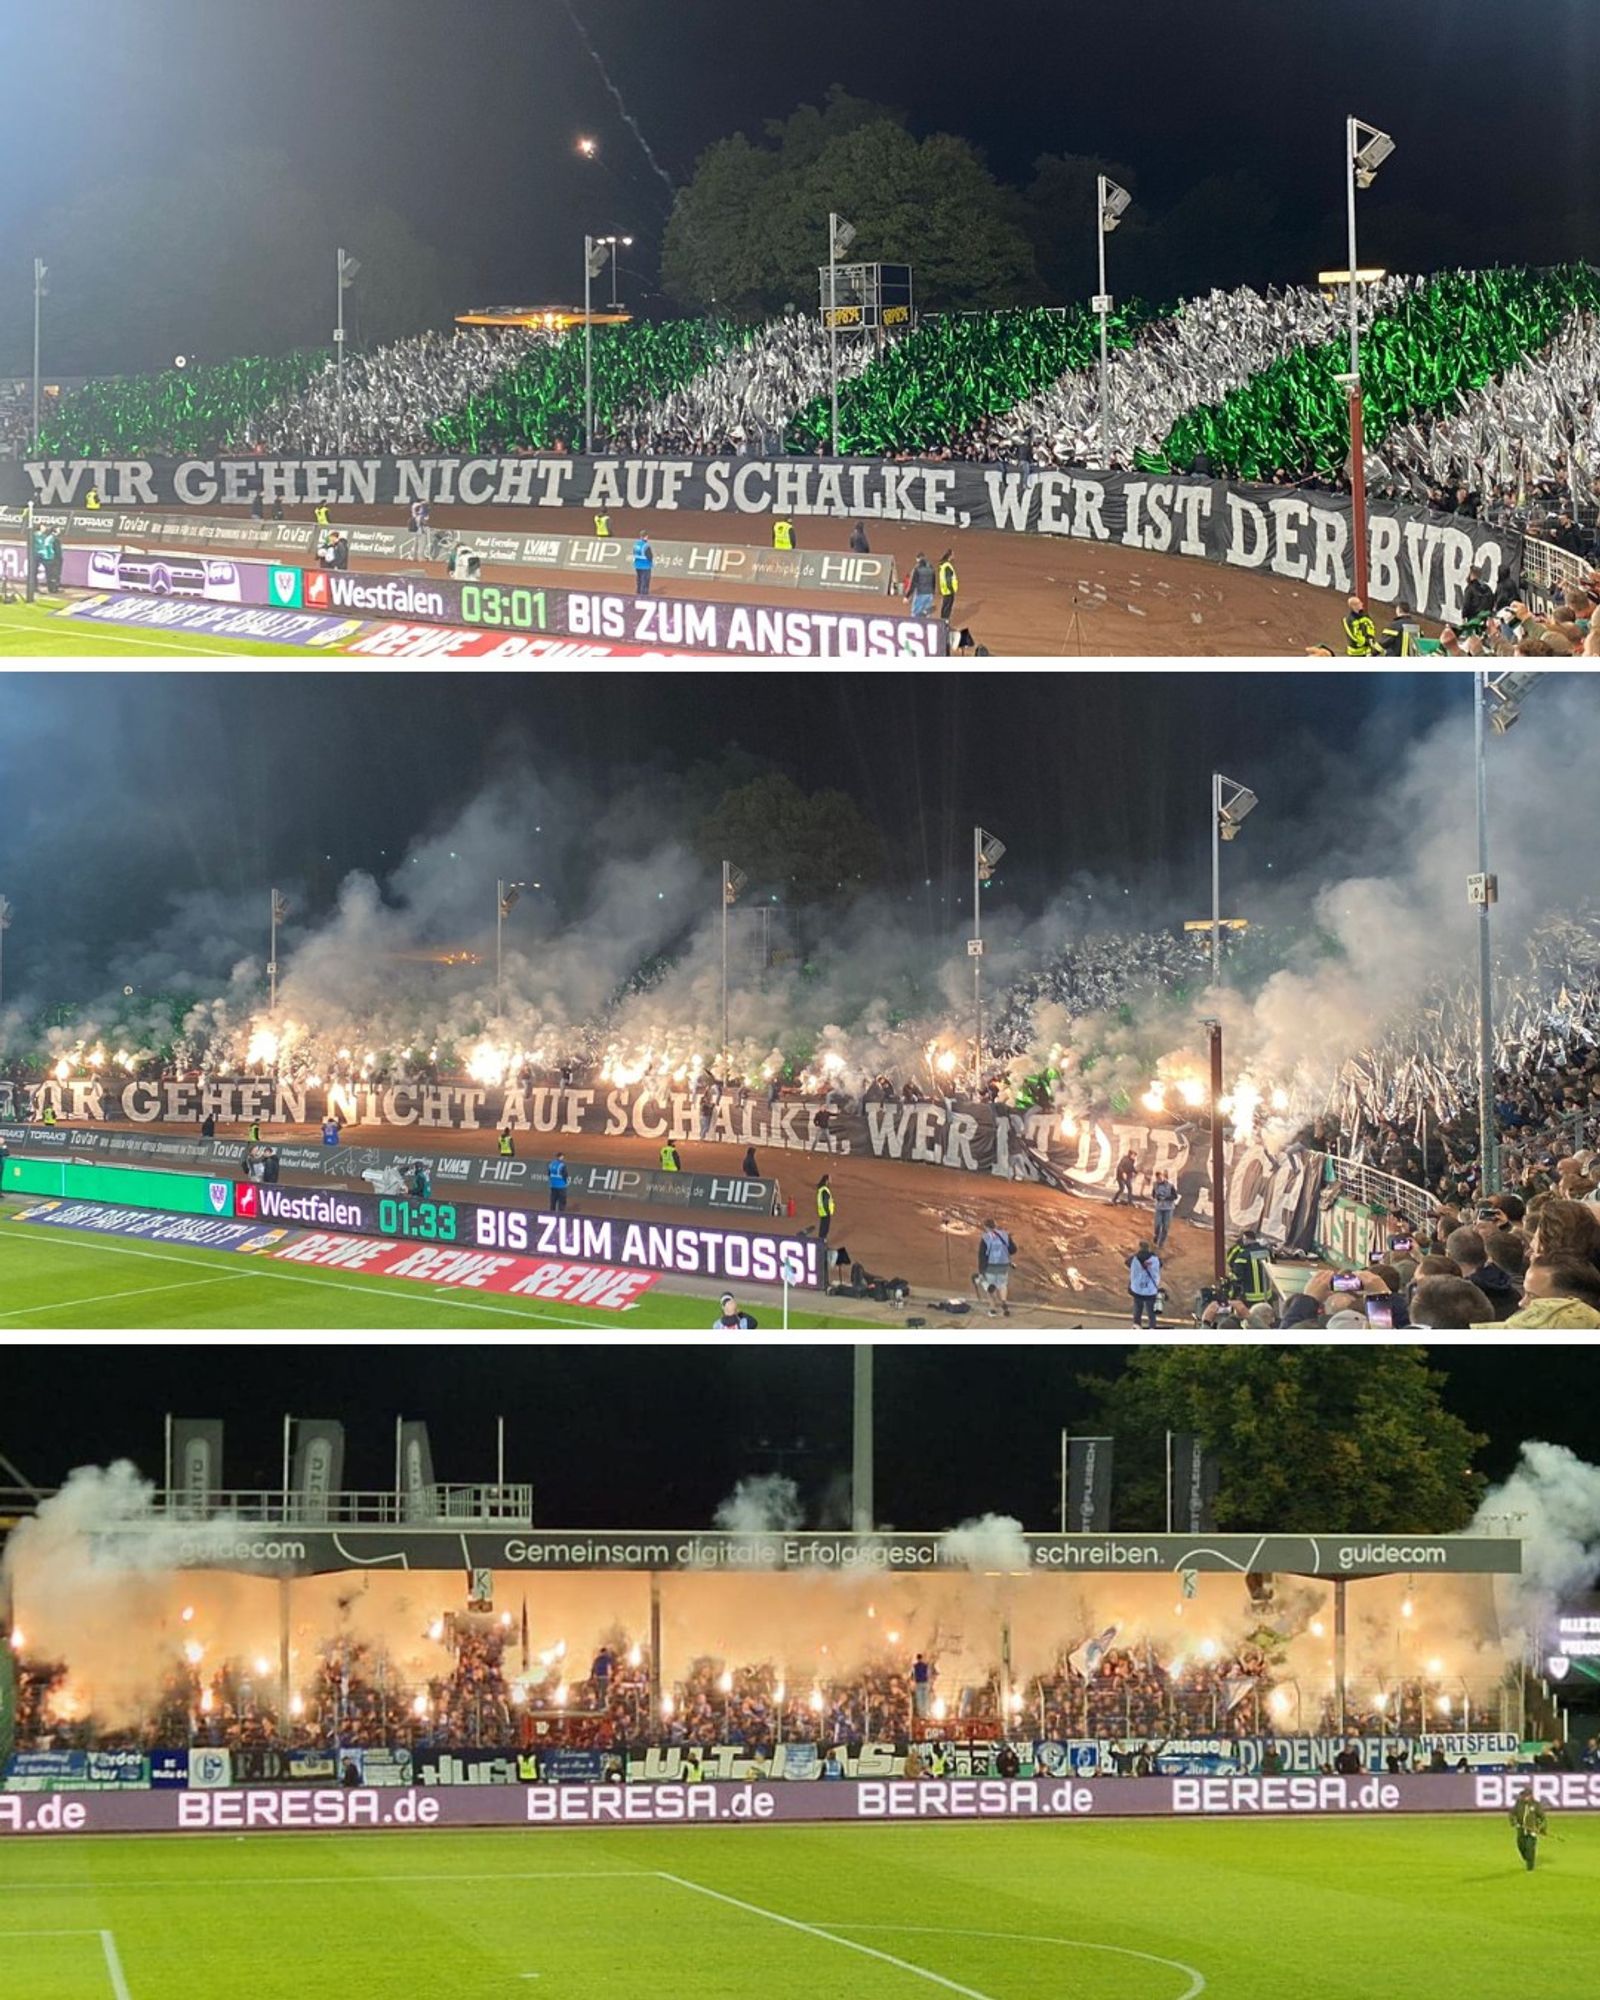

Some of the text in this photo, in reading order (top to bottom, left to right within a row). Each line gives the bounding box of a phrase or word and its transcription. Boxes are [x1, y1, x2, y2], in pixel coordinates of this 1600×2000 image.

[24, 460, 158, 505] WIR
[174, 459, 384, 505] GEHEN
[394, 459, 572, 507] NICHT
[583, 460, 694, 510] AUF
[704, 461, 971, 530] SCHALKE,
[985, 469, 1110, 542] WER
[1122, 481, 1211, 557] IST
[1226, 493, 1351, 593] DER
[118, 515, 149, 532] Tovar
[275, 524, 313, 543] Tovar
[570, 540, 621, 562] HIP
[689, 547, 746, 572] HIP
[820, 556, 882, 582] HIP
[330, 575, 443, 616] Westfalen
[461, 585, 939, 656] 03:01 BIS ZUM ANSTOSS!
[70, 1131, 99, 1145] Tovar
[213, 1140, 245, 1158] Tovar
[121, 1081, 305, 1123] GEHEN
[322, 1083, 486, 1128] NICHT
[496, 1087, 595, 1133] AUF
[865, 1102, 979, 1170] WER
[479, 1159, 528, 1181] HIP
[587, 1168, 641, 1191] HIP
[709, 1178, 767, 1204] HIP
[260, 1189, 362, 1227] Westfalen
[380, 1198, 818, 1286] 01:33 BIS ZUM ANSTOSS!
[274, 1234, 397, 1269] REWE
[384, 1247, 516, 1287] REWE
[508, 1263, 653, 1310] REWE
[503, 1539, 670, 1563] Gemeinsam
[675, 1538, 777, 1569] digitale
[1036, 1544, 1165, 1565] schreiben.
[1338, 1544, 1447, 1569] guidecom
[1422, 1734, 1517, 1754] HARTSFELD
[178, 1789, 440, 1828] BERESA.de
[527, 1783, 775, 1821] BERESA.de
[857, 1780, 1093, 1816] BERESA.de
[1172, 1775, 1400, 1812] BERESA.de
